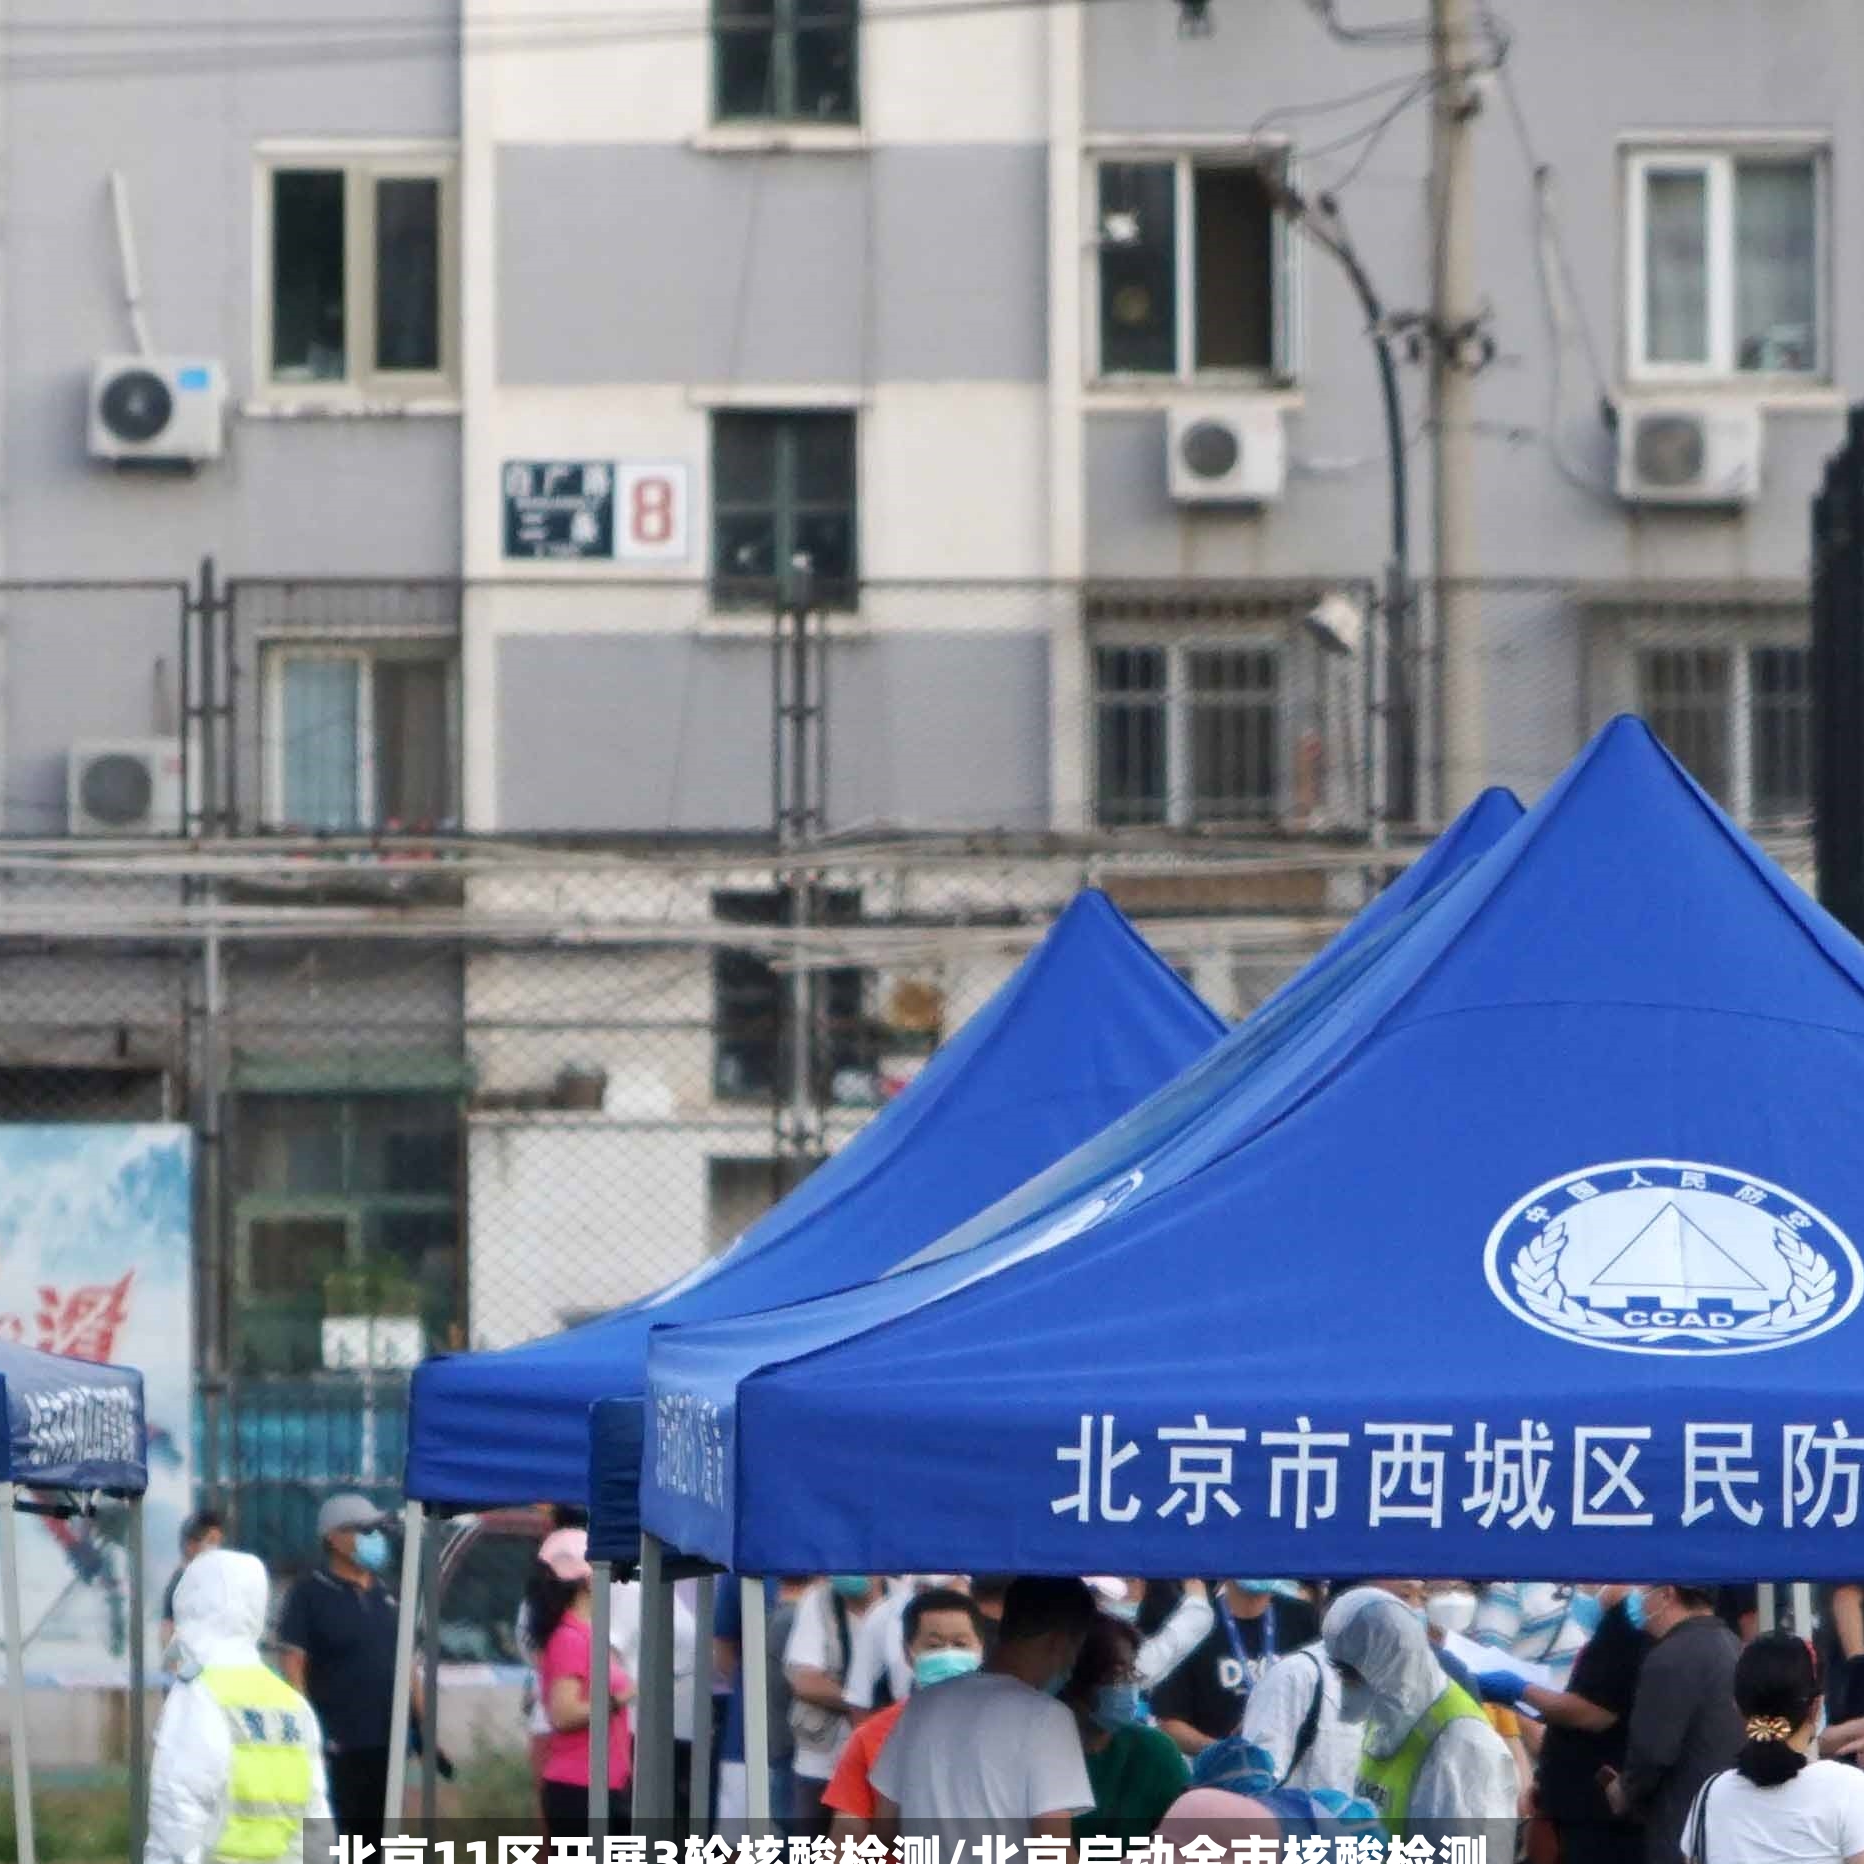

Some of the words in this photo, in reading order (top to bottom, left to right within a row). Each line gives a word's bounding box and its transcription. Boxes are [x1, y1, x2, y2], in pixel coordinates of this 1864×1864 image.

[632, 477, 674, 544] 8
[1524, 1169, 1814, 1231] 中国人民防空
[1623, 1310, 1736, 1328] CCAD
